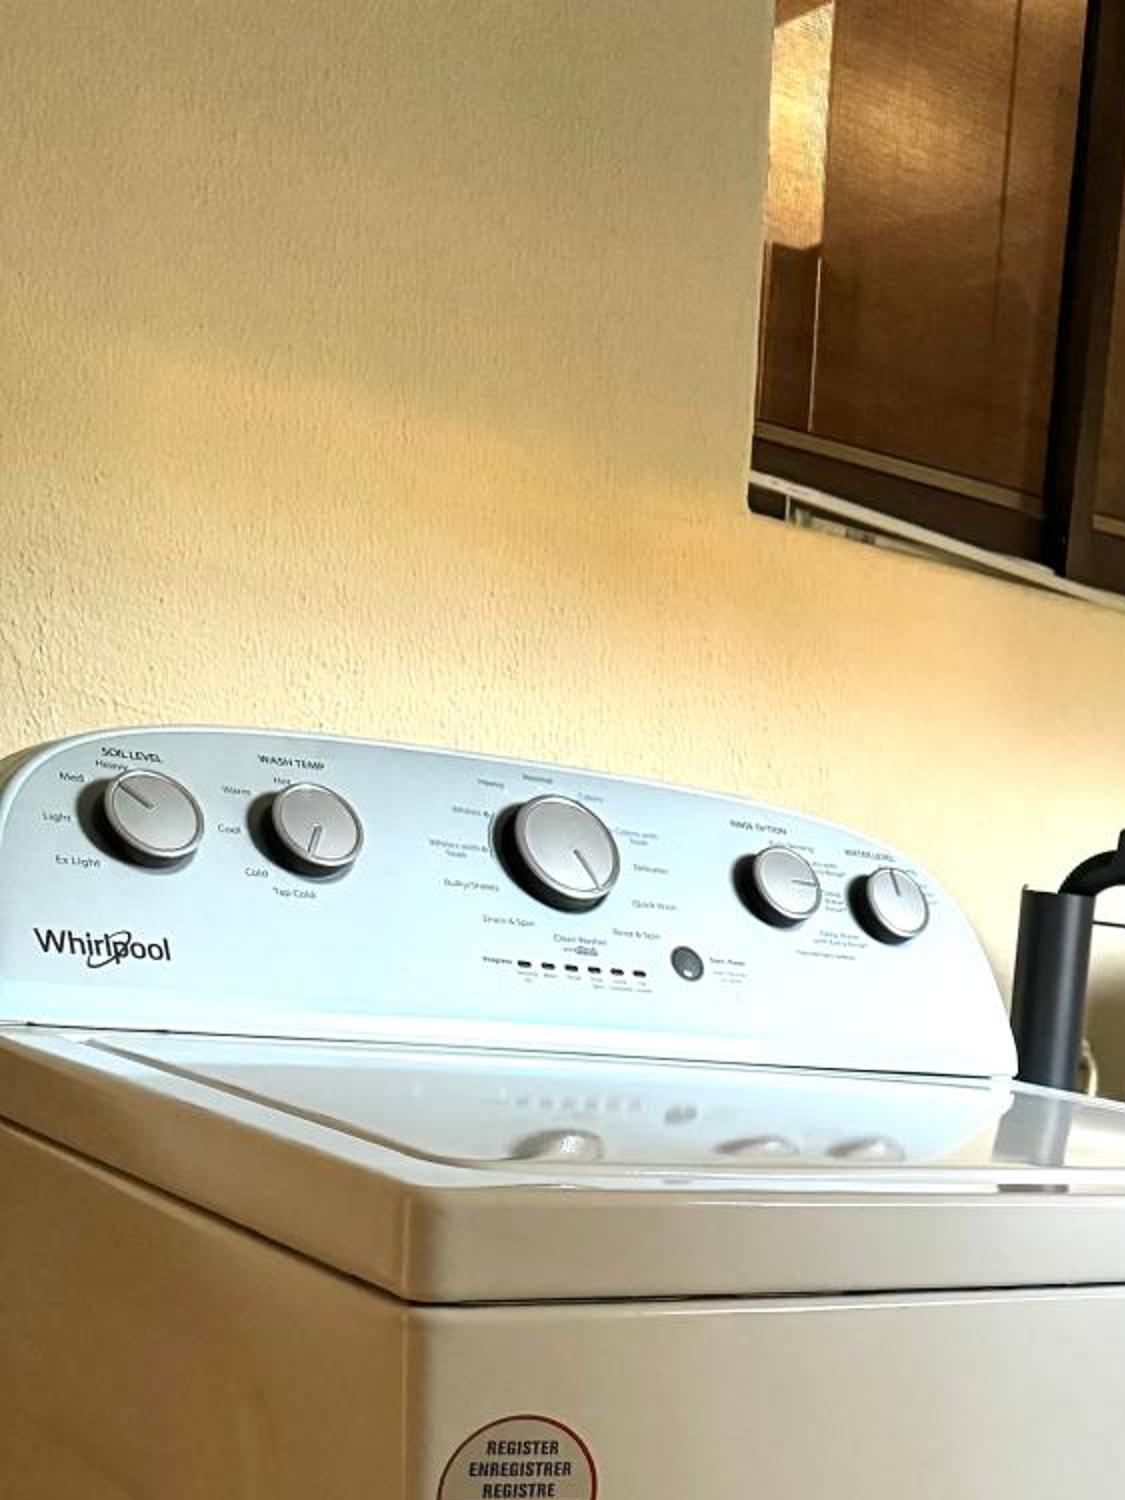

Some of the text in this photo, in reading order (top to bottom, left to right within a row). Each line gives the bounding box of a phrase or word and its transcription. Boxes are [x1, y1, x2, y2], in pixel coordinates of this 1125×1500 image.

[129, 751, 162, 763] LEVEL
[258, 755, 325, 770] WASH TEMP
[60, 771, 85, 783] Med
[222, 785, 251, 796] Warm
[42, 811, 72, 823] Light
[217, 823, 241, 835] Cool
[55, 854, 101, 868] Ex Light
[244, 867, 270, 879] Cold
[33, 926, 172, 969] Whirlpool
[486, 1439, 560, 1456] REGISTER
[468, 1461, 572, 1477] ENREGISTRER
[481, 1482, 557, 1499] REGISTRE
